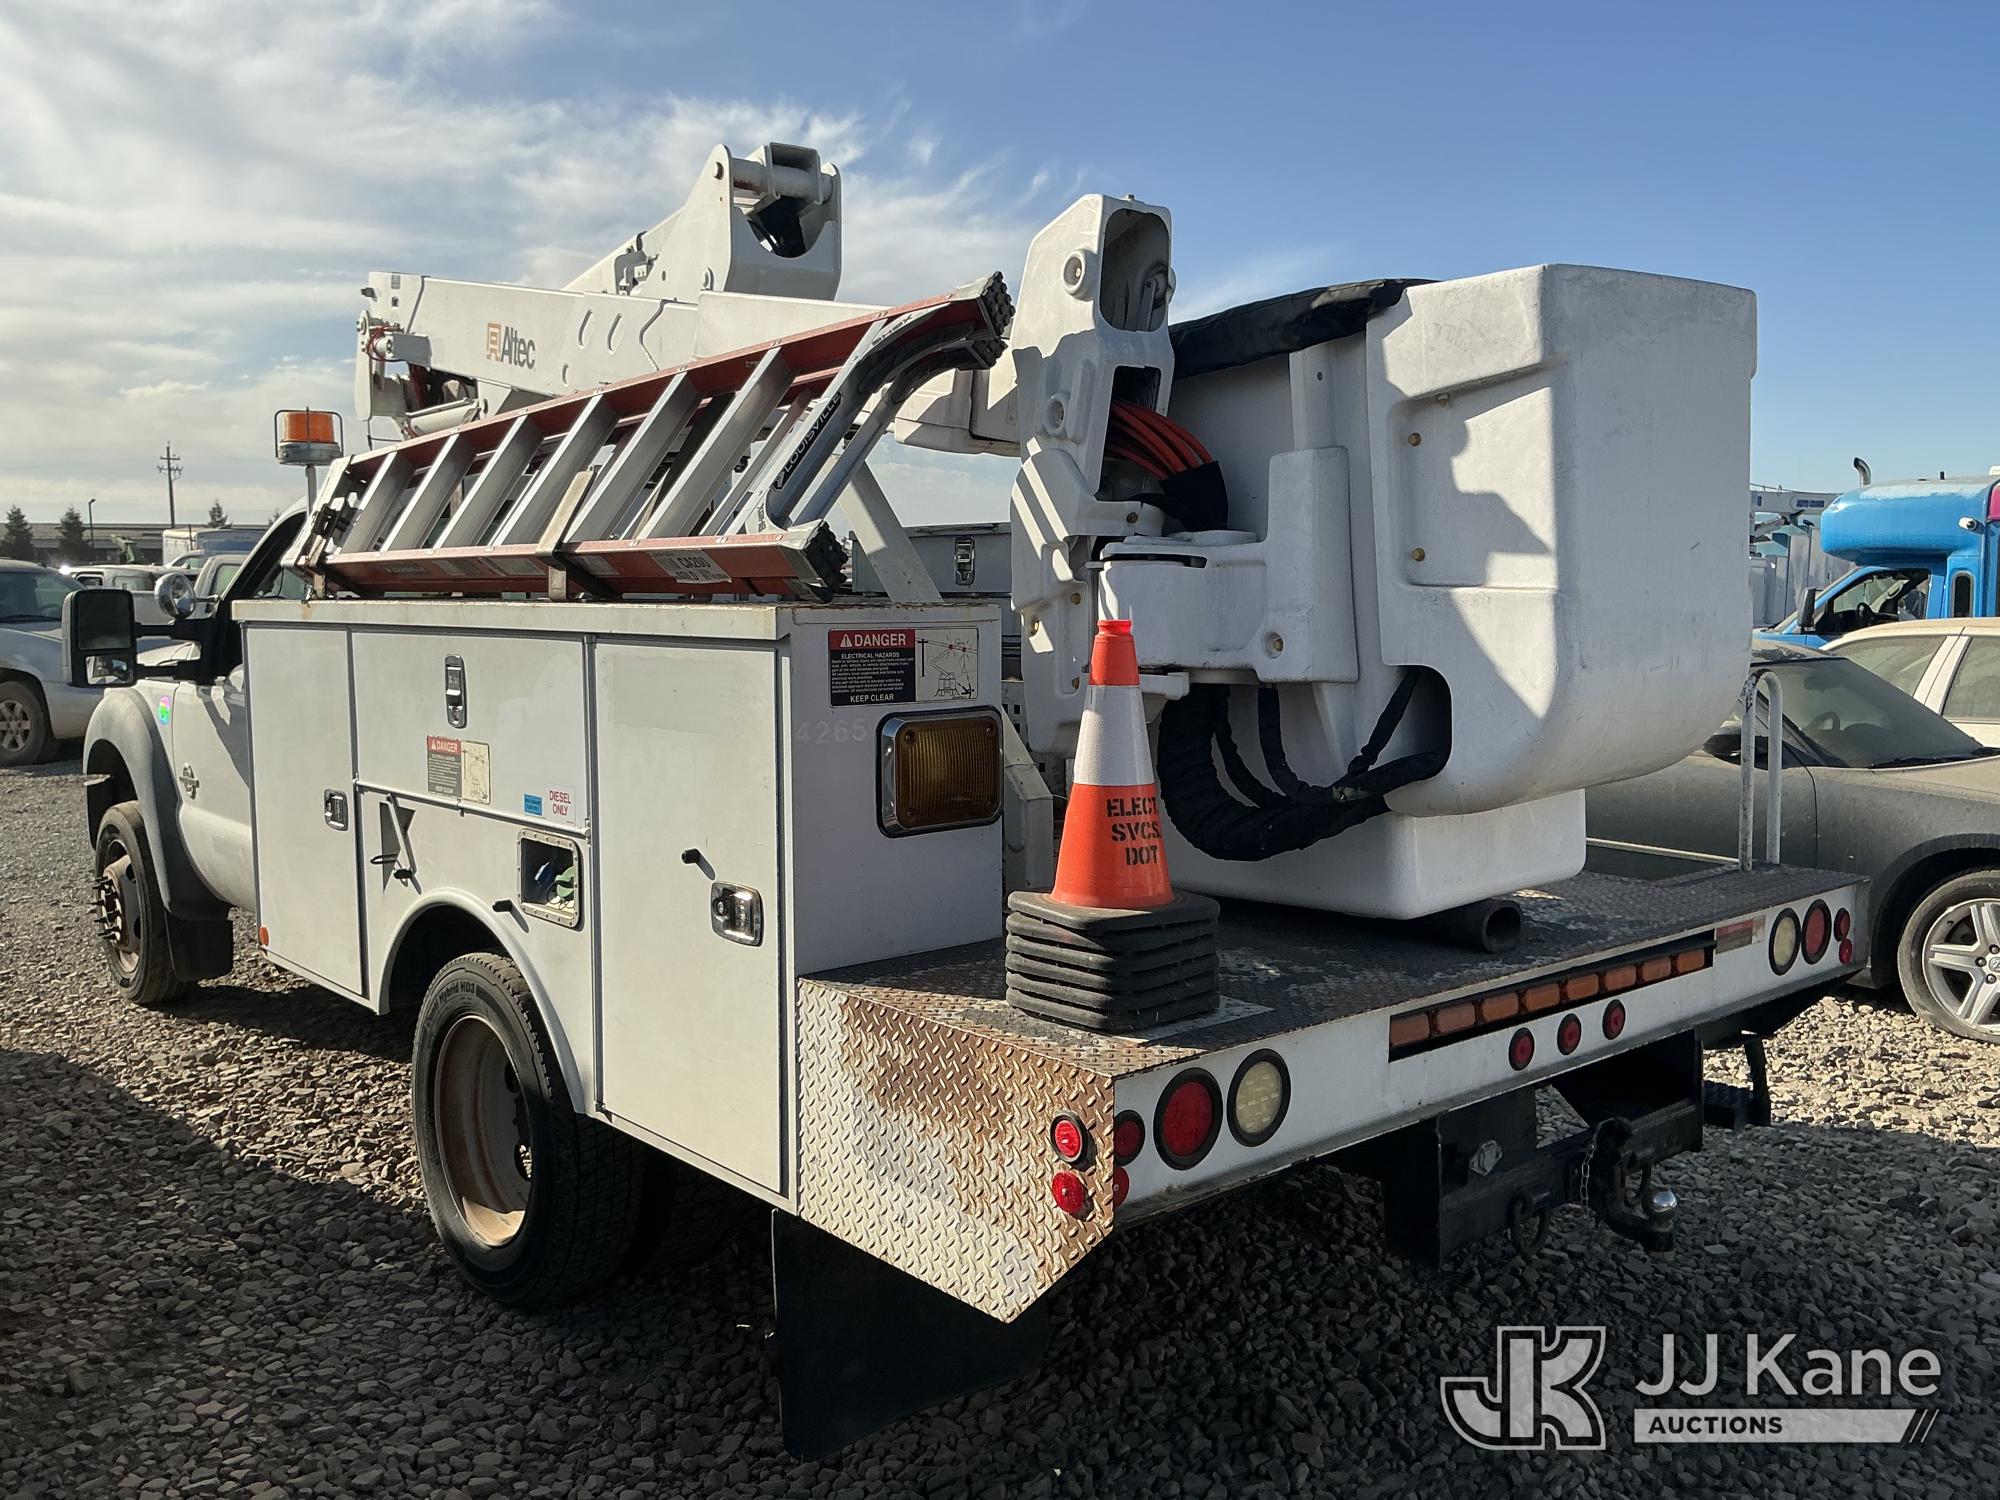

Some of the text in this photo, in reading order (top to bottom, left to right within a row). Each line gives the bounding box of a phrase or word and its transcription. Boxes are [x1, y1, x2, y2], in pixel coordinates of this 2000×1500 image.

[501, 326, 535, 370] Altec
[785, 392, 842, 473] LOUISVILLE
[854, 633, 906, 648] DANGER
[850, 693, 894, 703] KEEP CLEAR
[797, 719, 867, 744] 4265
[436, 740, 458, 753] DANGER
[549, 790, 571, 804] DIESEL
[552, 803, 569, 816] ONLY
[1125, 845, 1158, 866] DOT
[439, 980, 475, 1002] Hybrid HD3
